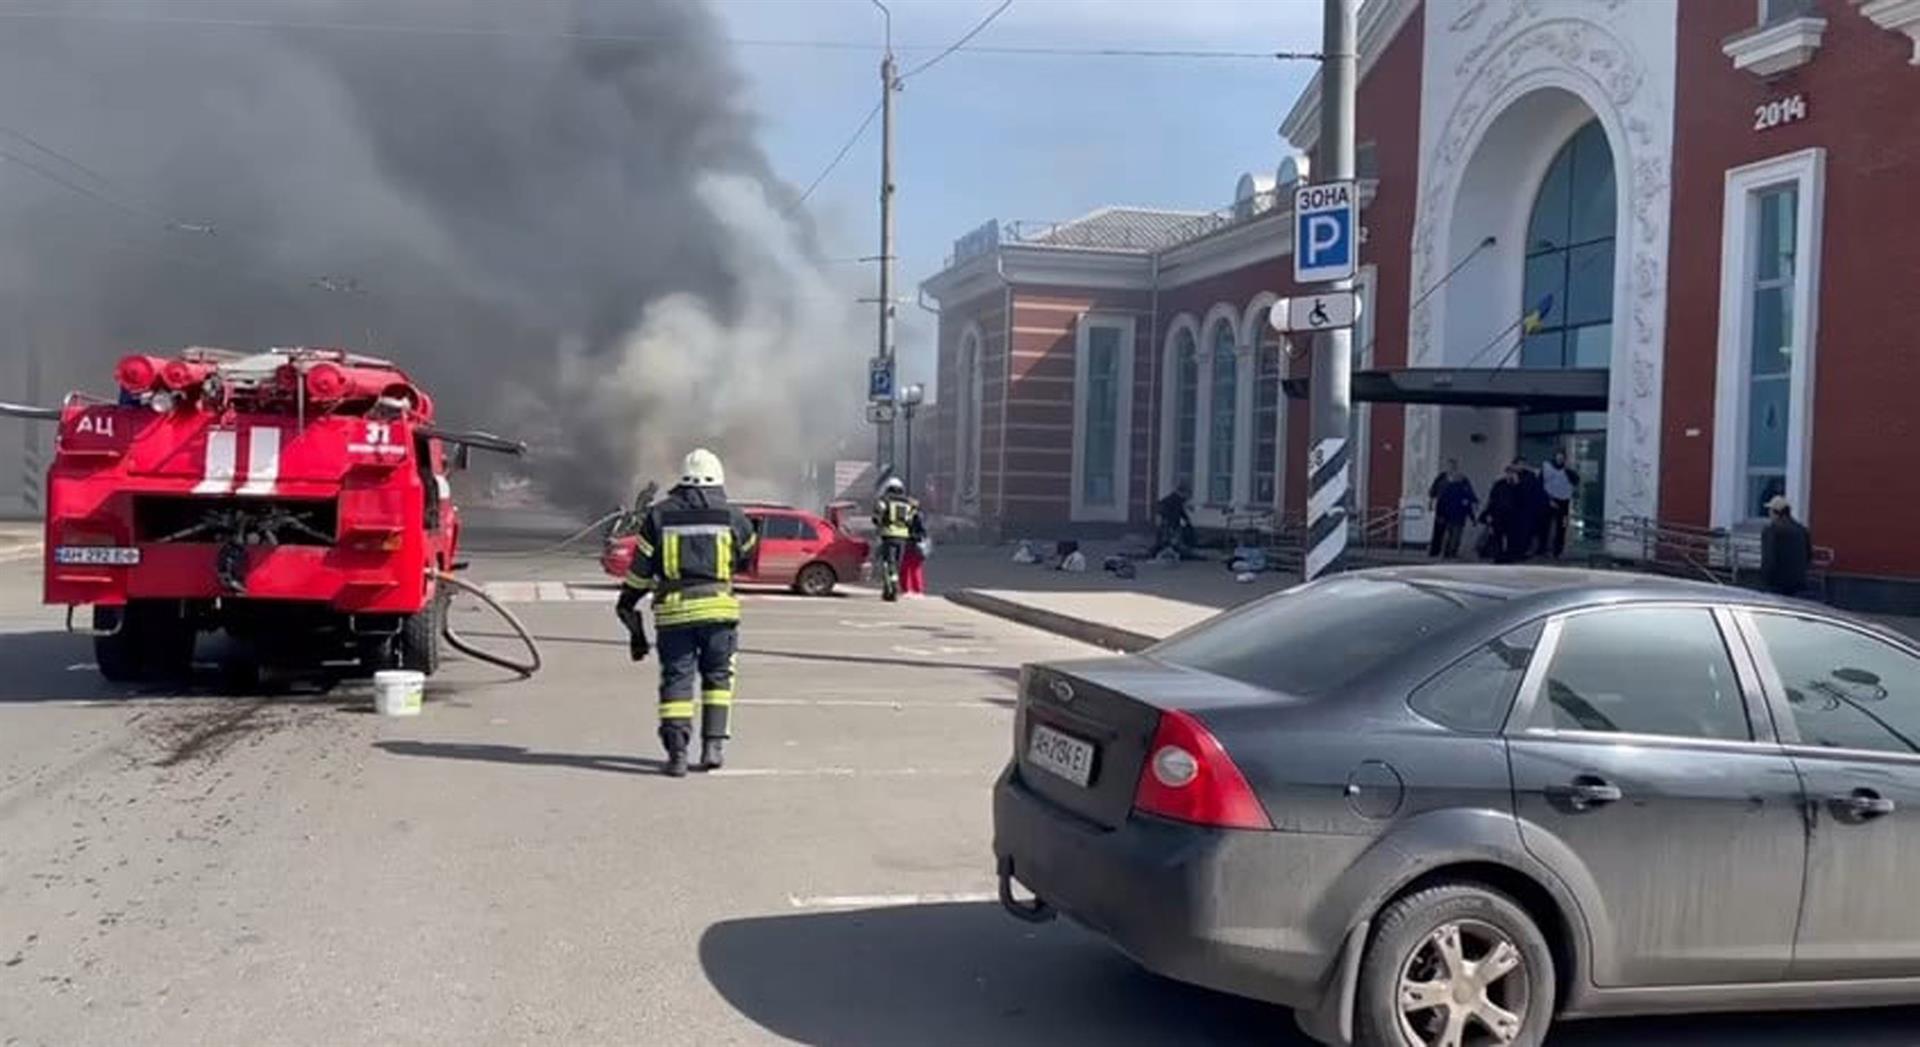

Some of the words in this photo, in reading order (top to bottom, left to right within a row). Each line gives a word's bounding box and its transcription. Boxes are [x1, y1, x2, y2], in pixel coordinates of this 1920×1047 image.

[1754, 95, 1805, 130] 2014
[1300, 187, 1348, 210] ЗОНА
[1309, 216, 1340, 265] P
[76, 415, 113, 437] АЦ
